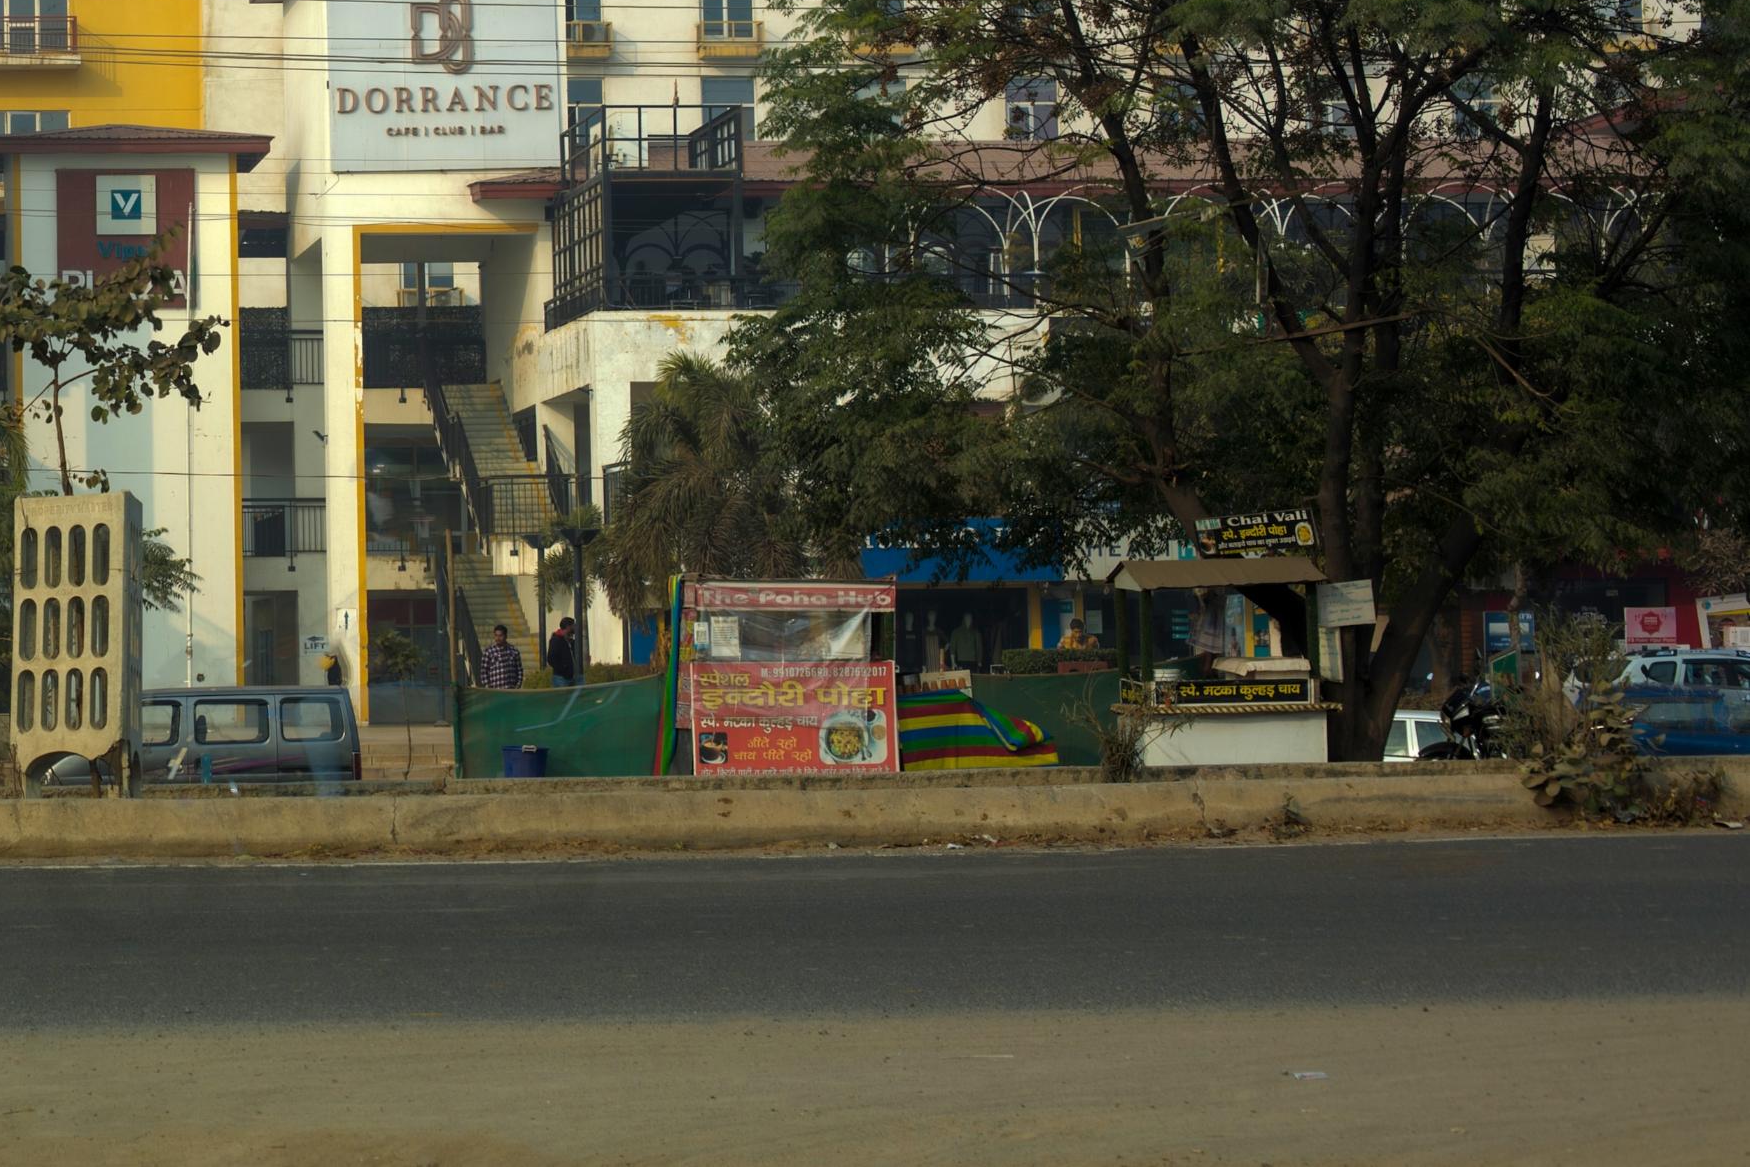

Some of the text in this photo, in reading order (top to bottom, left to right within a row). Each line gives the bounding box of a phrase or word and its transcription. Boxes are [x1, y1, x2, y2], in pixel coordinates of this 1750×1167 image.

[336, 84, 555, 115] DORRANCE
[386, 124, 506, 137] CAFE CLUB BAR
[1226, 513, 1269, 527] Chai
[1273, 509, 1308, 523] Vali
[701, 589, 892, 606] The Poha Hub
[304, 642, 326, 650] LIFT
[813, 683, 887, 708] पोहा
[1203, 684, 1238, 696] मटका
[1278, 683, 1301, 695] चाय
